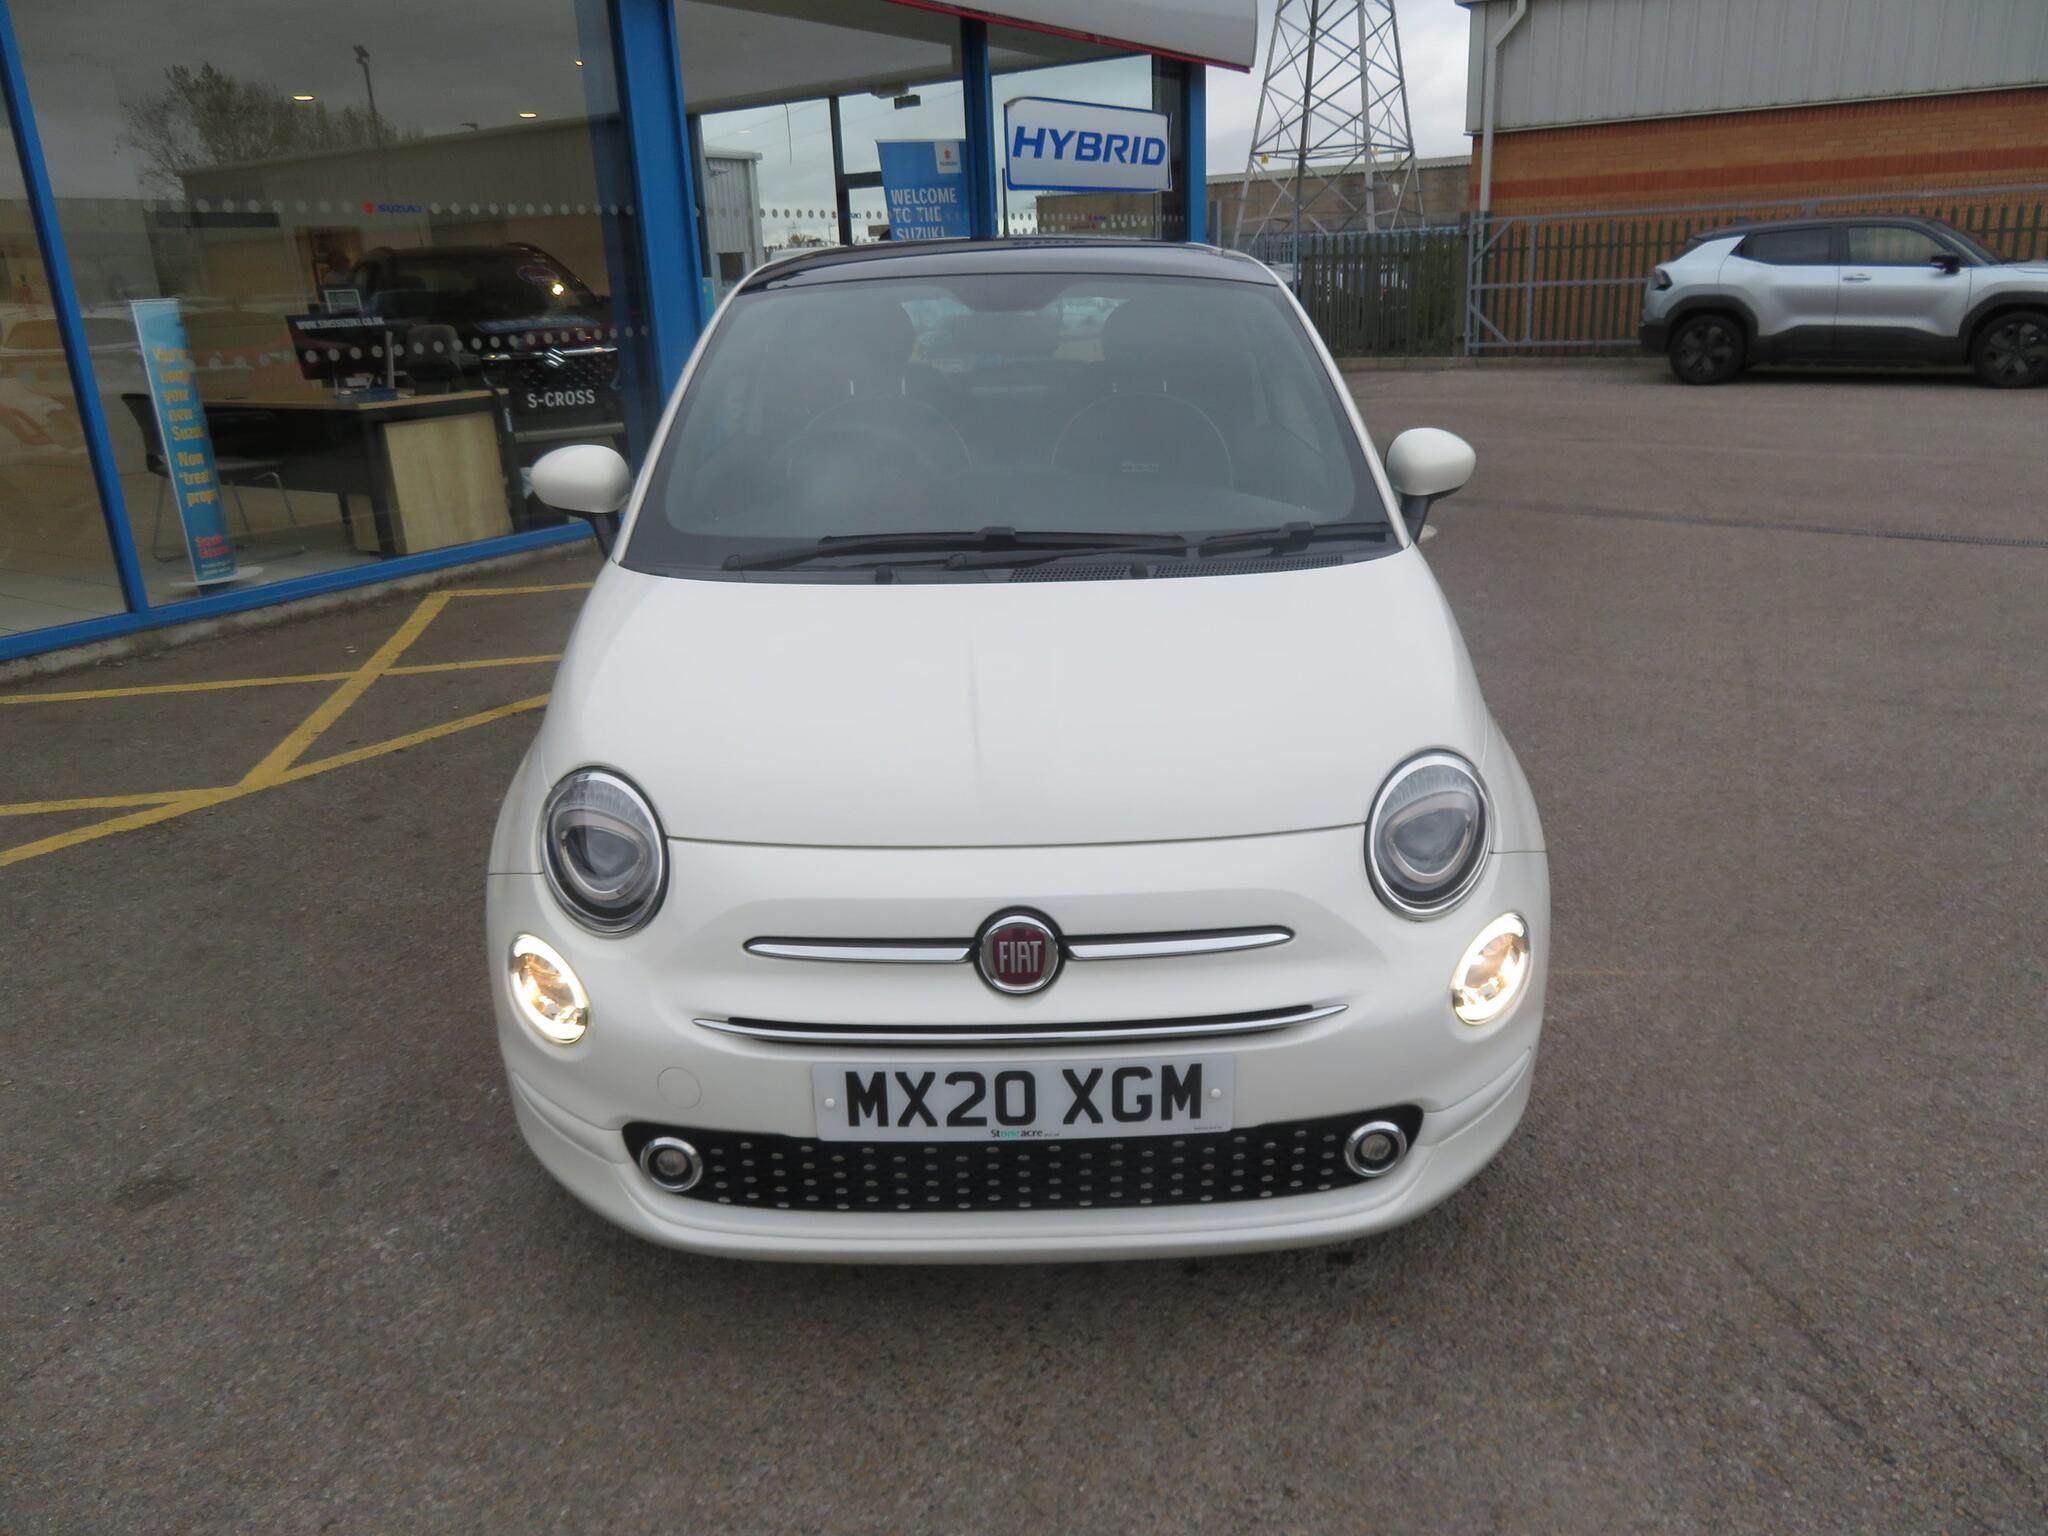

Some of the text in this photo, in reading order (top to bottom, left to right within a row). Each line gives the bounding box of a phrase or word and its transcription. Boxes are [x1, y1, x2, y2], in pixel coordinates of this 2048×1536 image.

[1012, 125, 1166, 166] HYBRID
[890, 188, 957, 205] WELCOME
[892, 206, 942, 224] TO THE
[896, 226, 945, 240] SUZUKI
[527, 389, 596, 409] S-CROSS
[999, 941, 1042, 974] FIAT
[845, 1063, 1202, 1127] MX20 XGM
